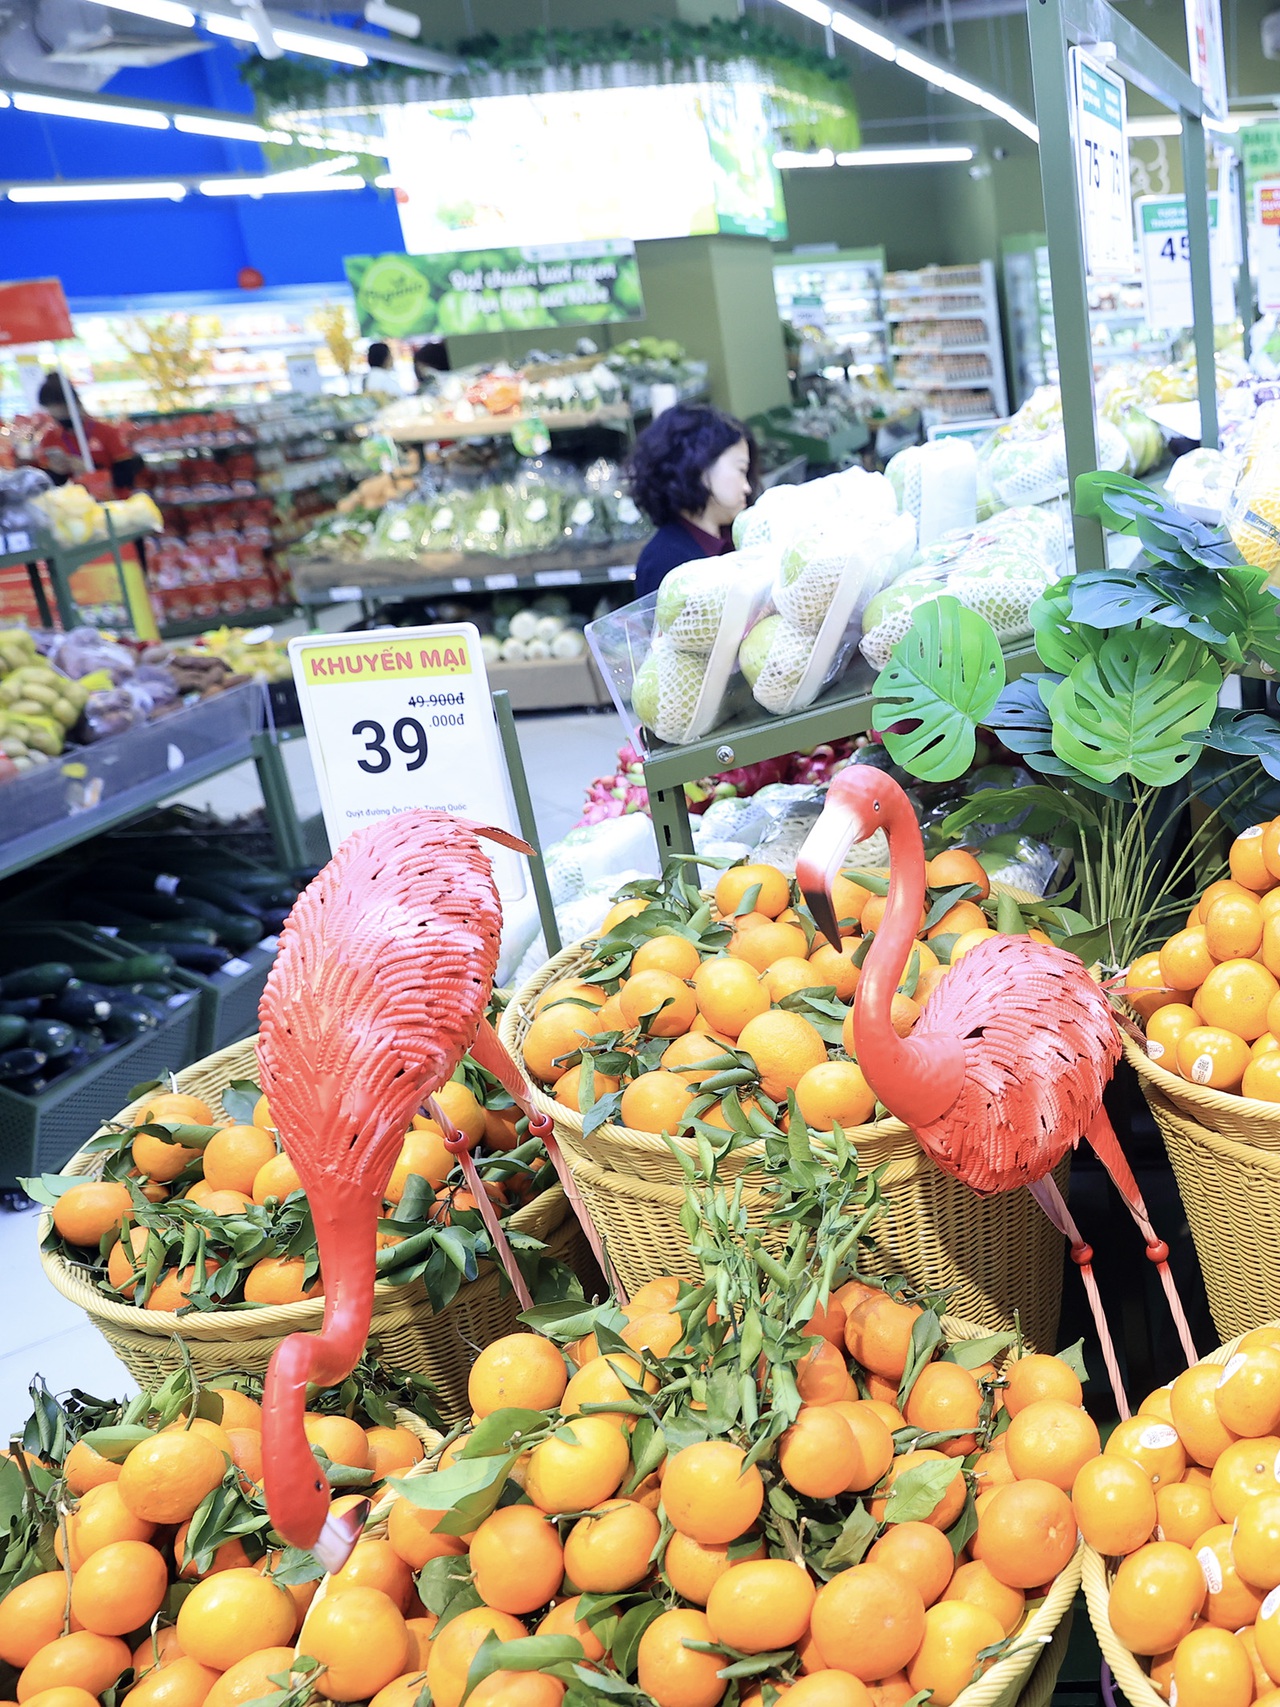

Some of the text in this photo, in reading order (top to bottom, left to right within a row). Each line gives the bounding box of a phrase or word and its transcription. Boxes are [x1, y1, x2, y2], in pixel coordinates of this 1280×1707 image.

[1085, 139, 1100, 188] 75
[311, 647, 466, 677] KHUYẾN MẠI
[408, 692, 465, 707] 49.900đ
[352, 717, 428, 774] 39
[345, 810, 364, 818] Quýt
[366, 808, 391, 817] đường
